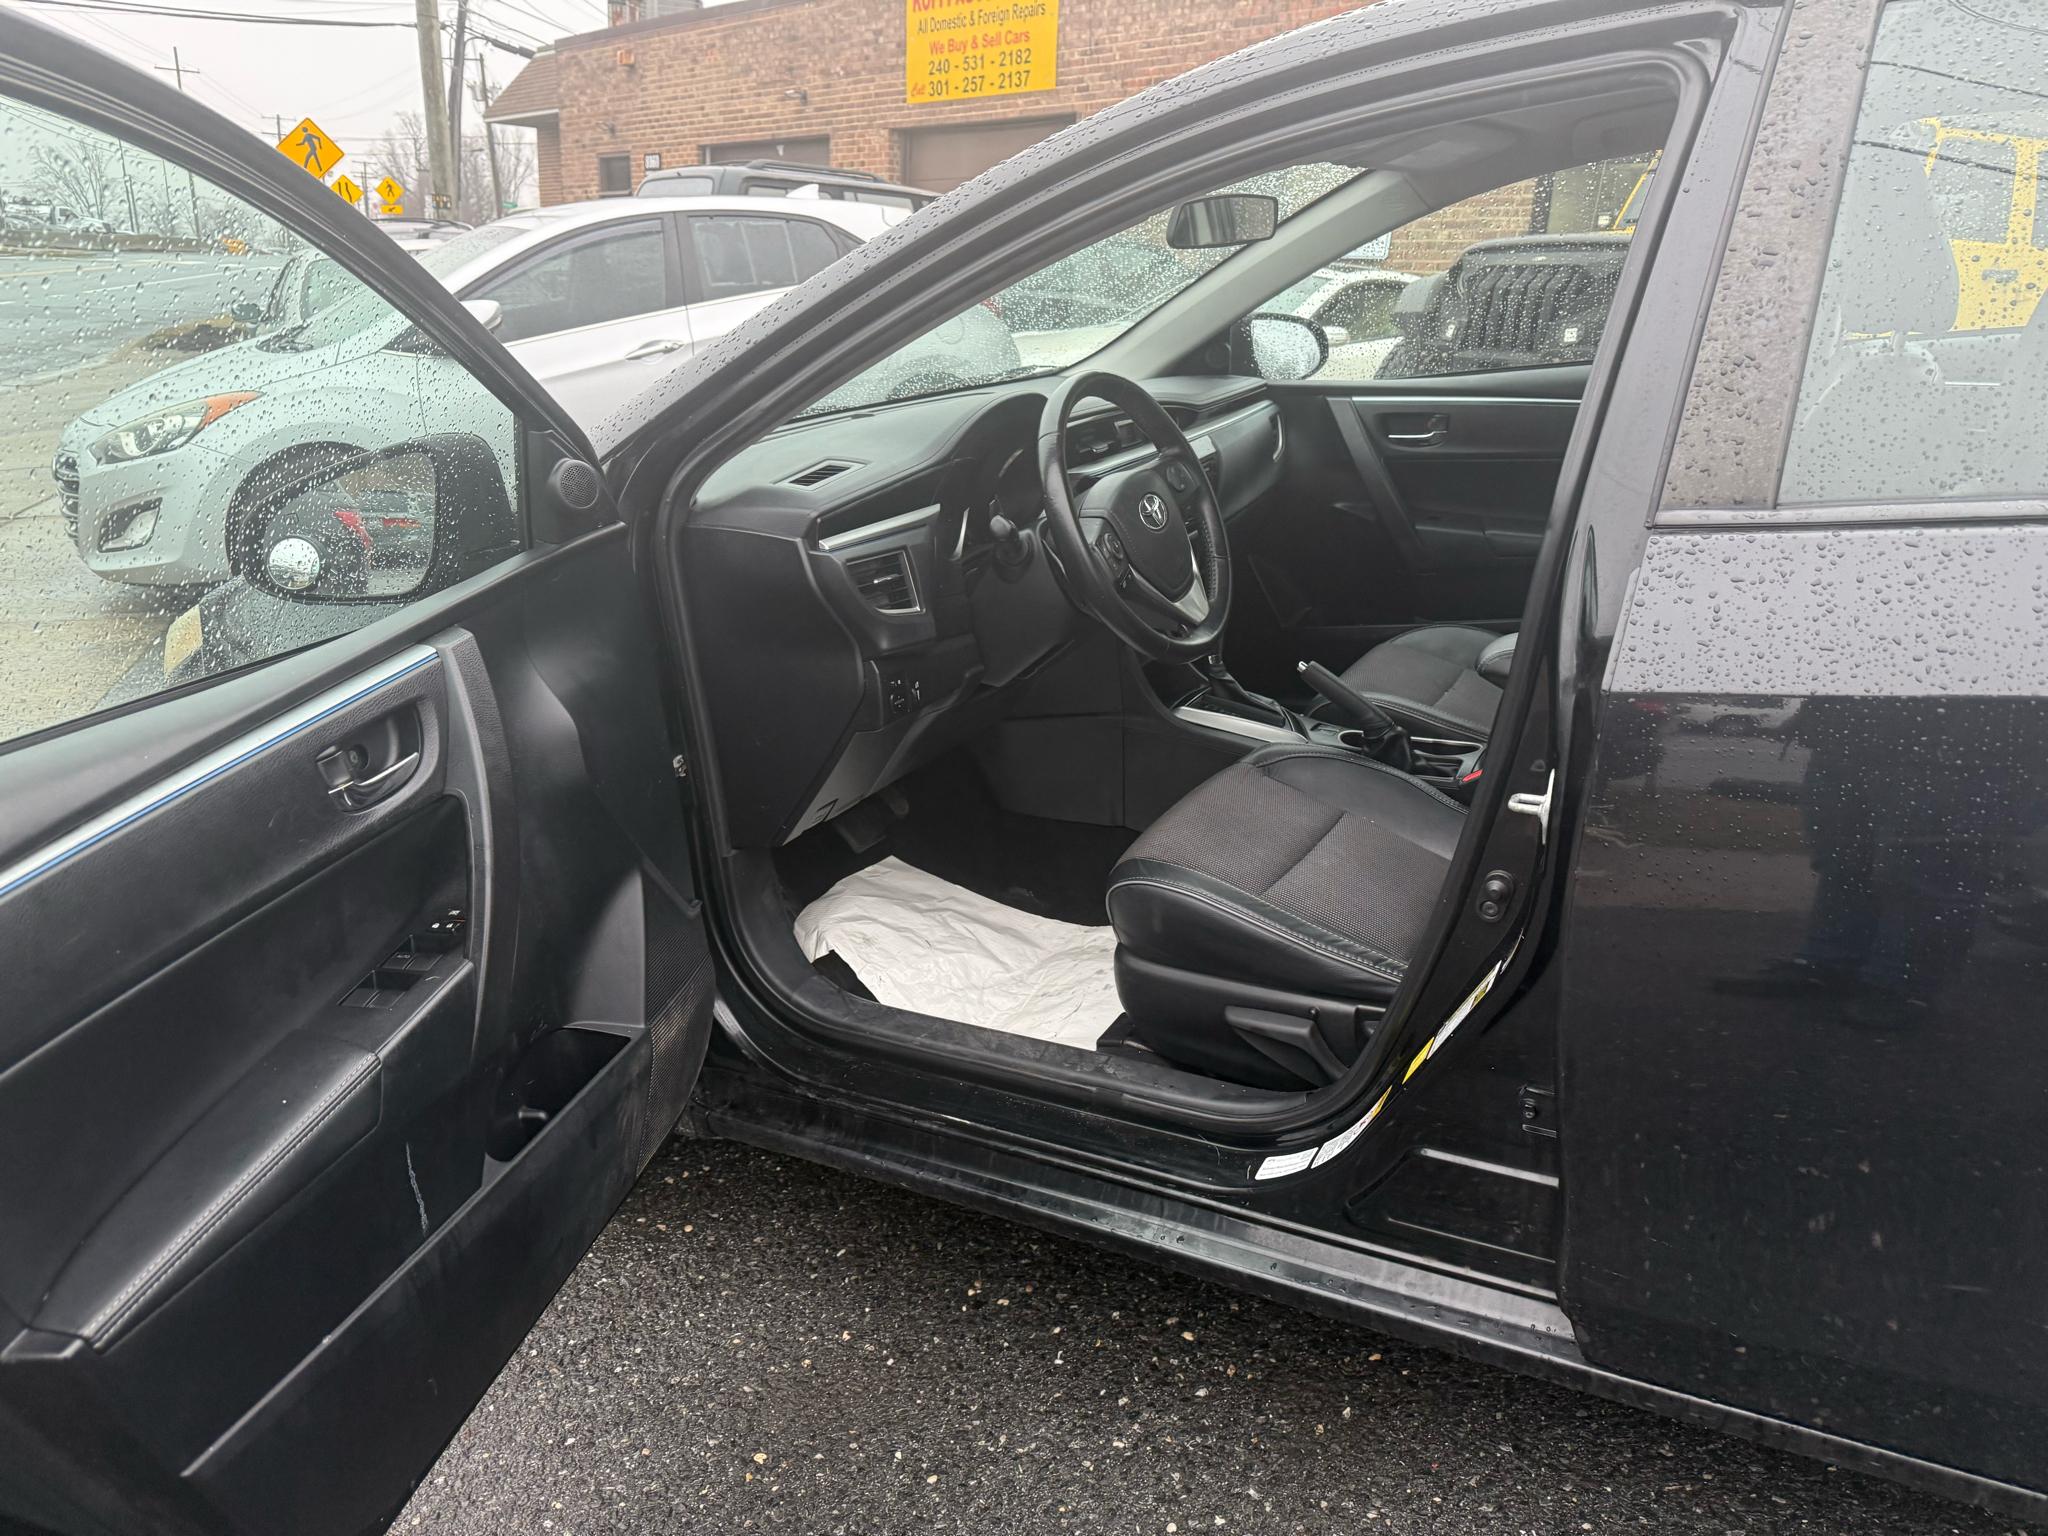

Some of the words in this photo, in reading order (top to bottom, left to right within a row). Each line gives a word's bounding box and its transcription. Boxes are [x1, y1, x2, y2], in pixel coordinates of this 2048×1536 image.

[917, 18, 929, 34] All
[930, 12, 967, 33] Domestic
[969, 10, 976, 27] &
[977, 6, 1010, 27] Foreign
[1012, 0, 1046, 23] Repairs
[929, 40, 945, 56] We
[947, 38, 968, 55] Buy
[971, 35, 979, 50] &
[982, 31, 1002, 49] Sell
[1004, 30, 1031, 46] Cars
[928, 58, 951, 76] 240
[963, 54, 985, 72] 531
[999, 47, 1032, 67] 2182
[928, 78, 950, 97] 301
[962, 75, 985, 93] 257
[998, 69, 1031, 89] 2137
